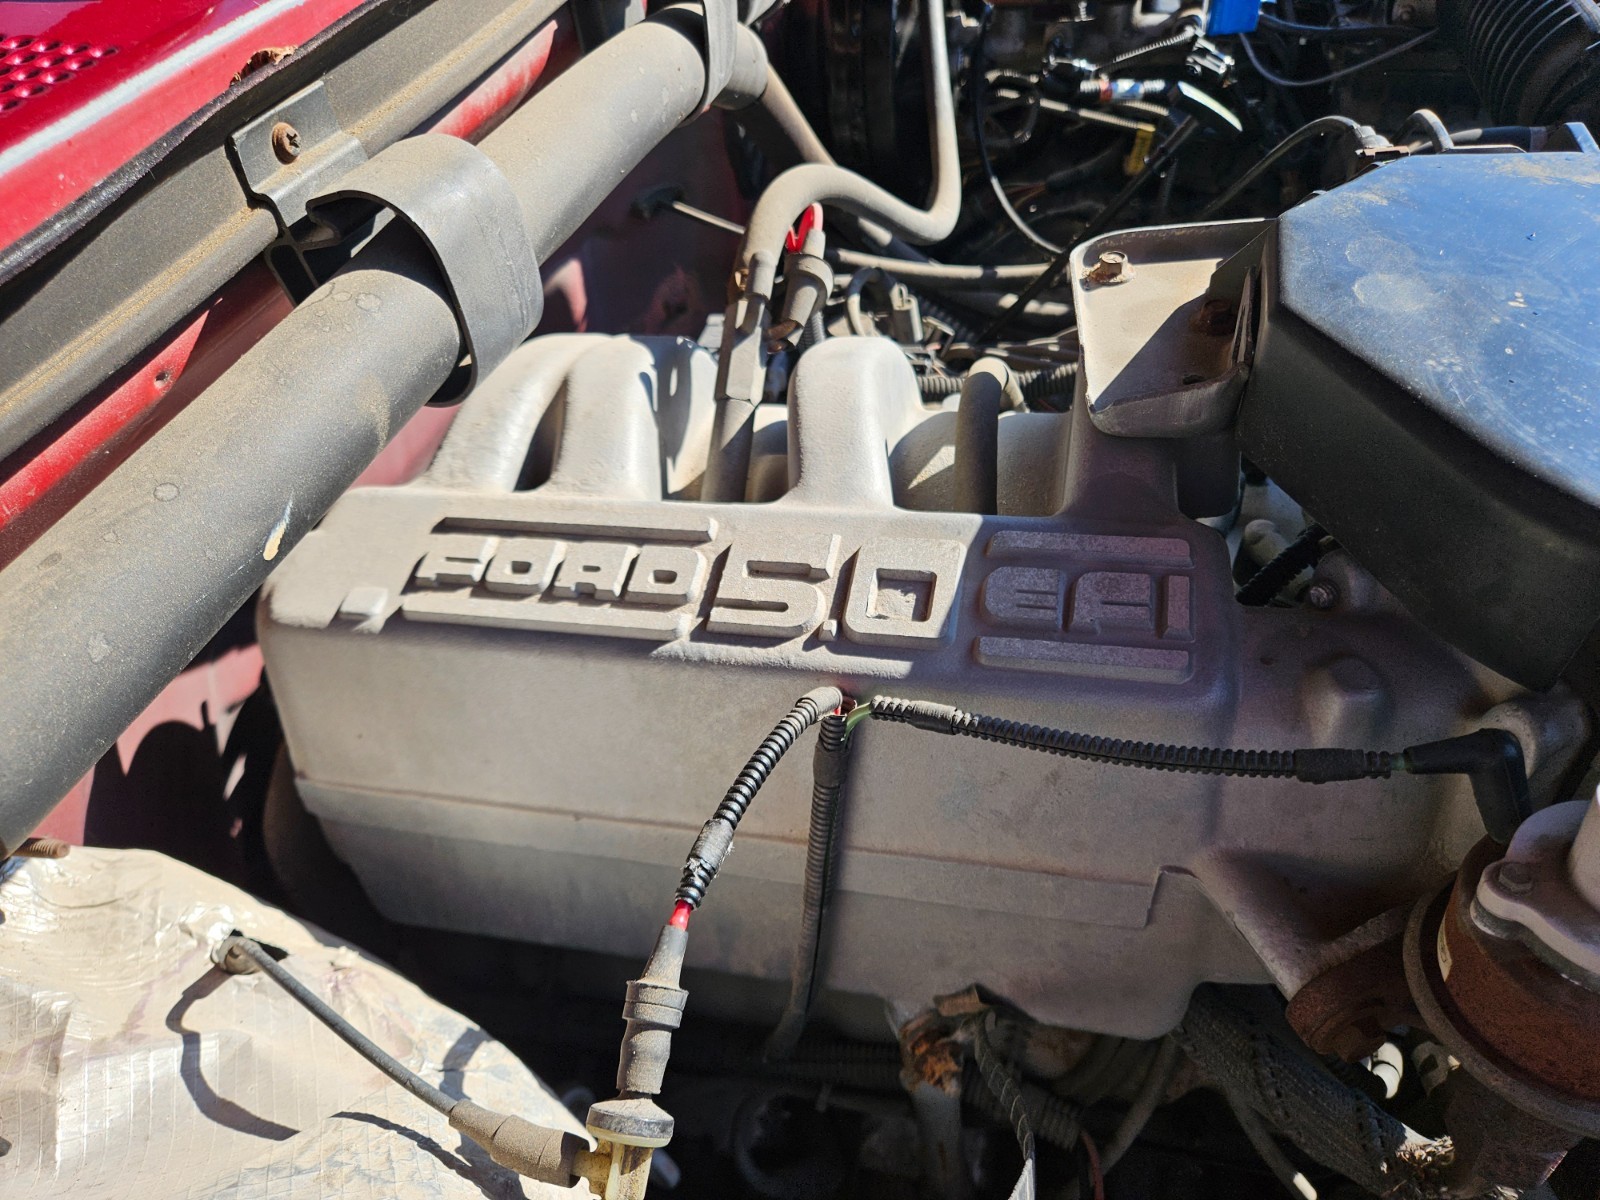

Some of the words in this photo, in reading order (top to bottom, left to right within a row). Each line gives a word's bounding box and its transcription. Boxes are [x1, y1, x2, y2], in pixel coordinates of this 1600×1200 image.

[414, 533, 706, 602] FORD
[706, 533, 966, 648] 5.0
[984, 566, 1196, 642] EFI
